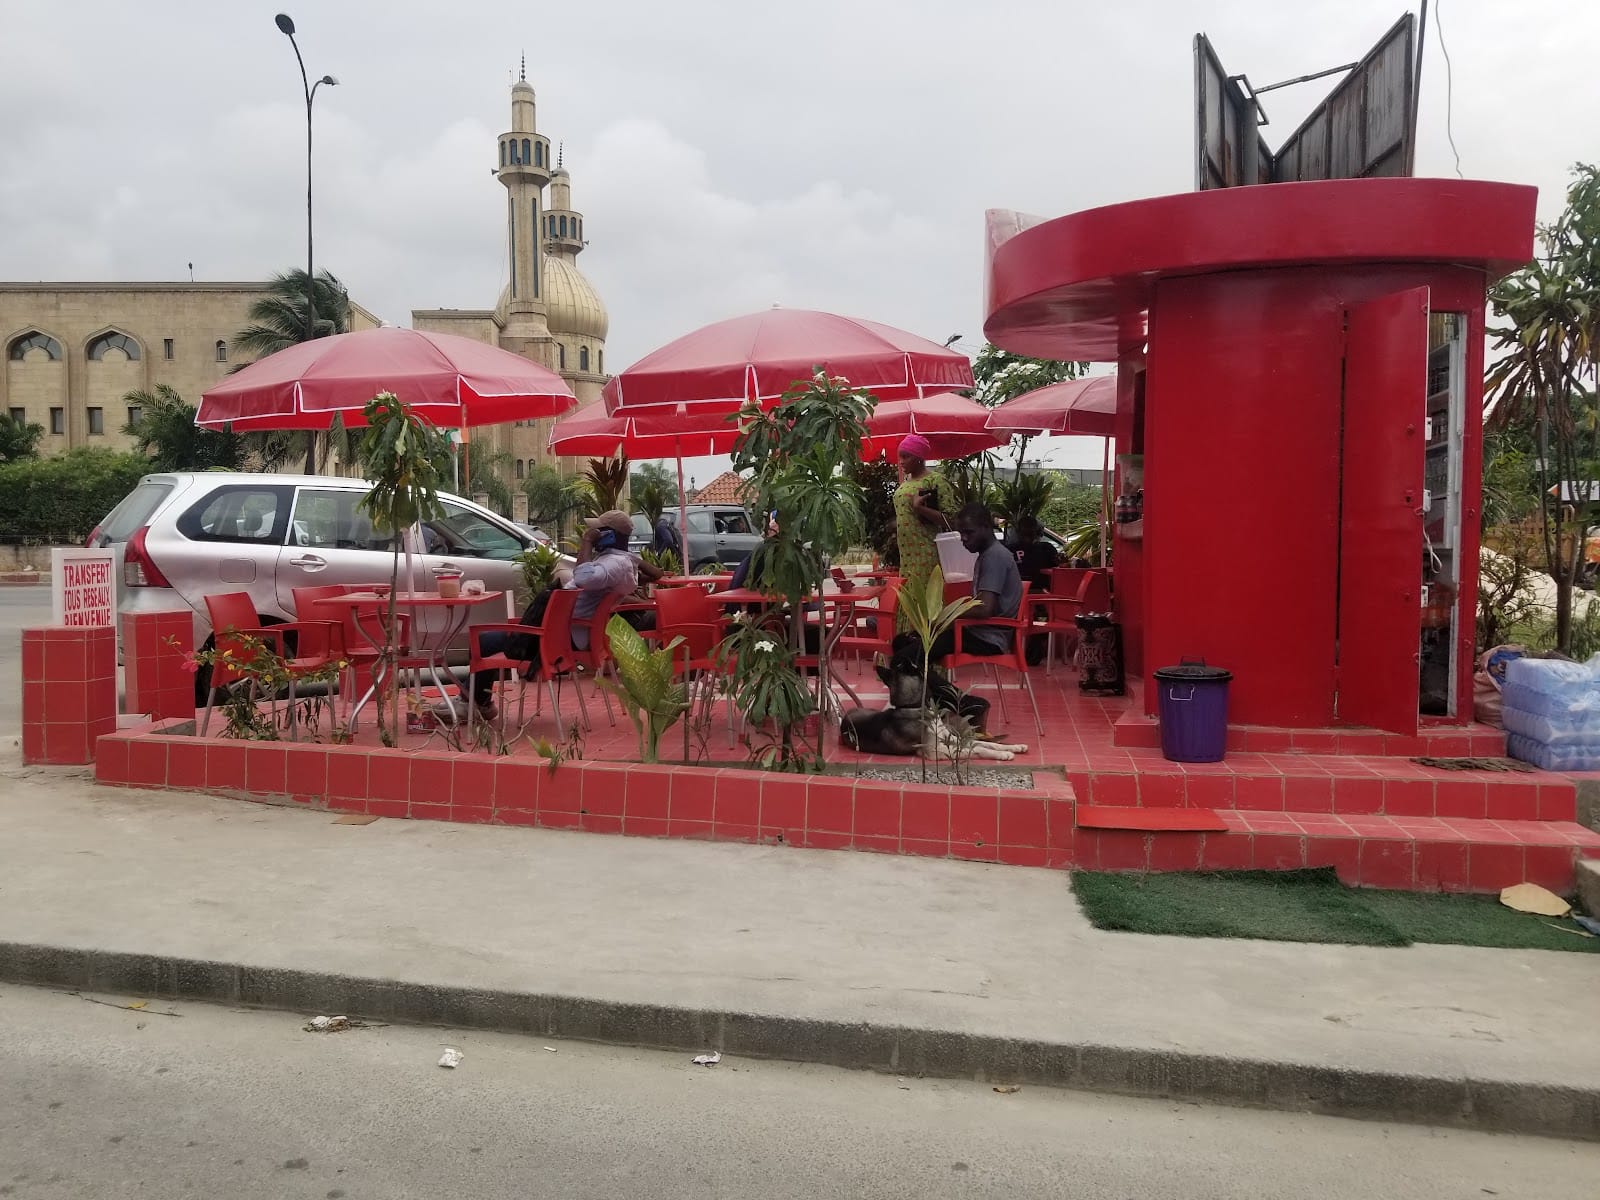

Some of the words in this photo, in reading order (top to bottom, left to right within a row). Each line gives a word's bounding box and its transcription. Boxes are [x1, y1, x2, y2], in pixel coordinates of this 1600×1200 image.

[64, 563, 110, 588] TRANSFERT
[64, 589, 80, 611] TOUS
[83, 586, 110, 608] RESEAUX
